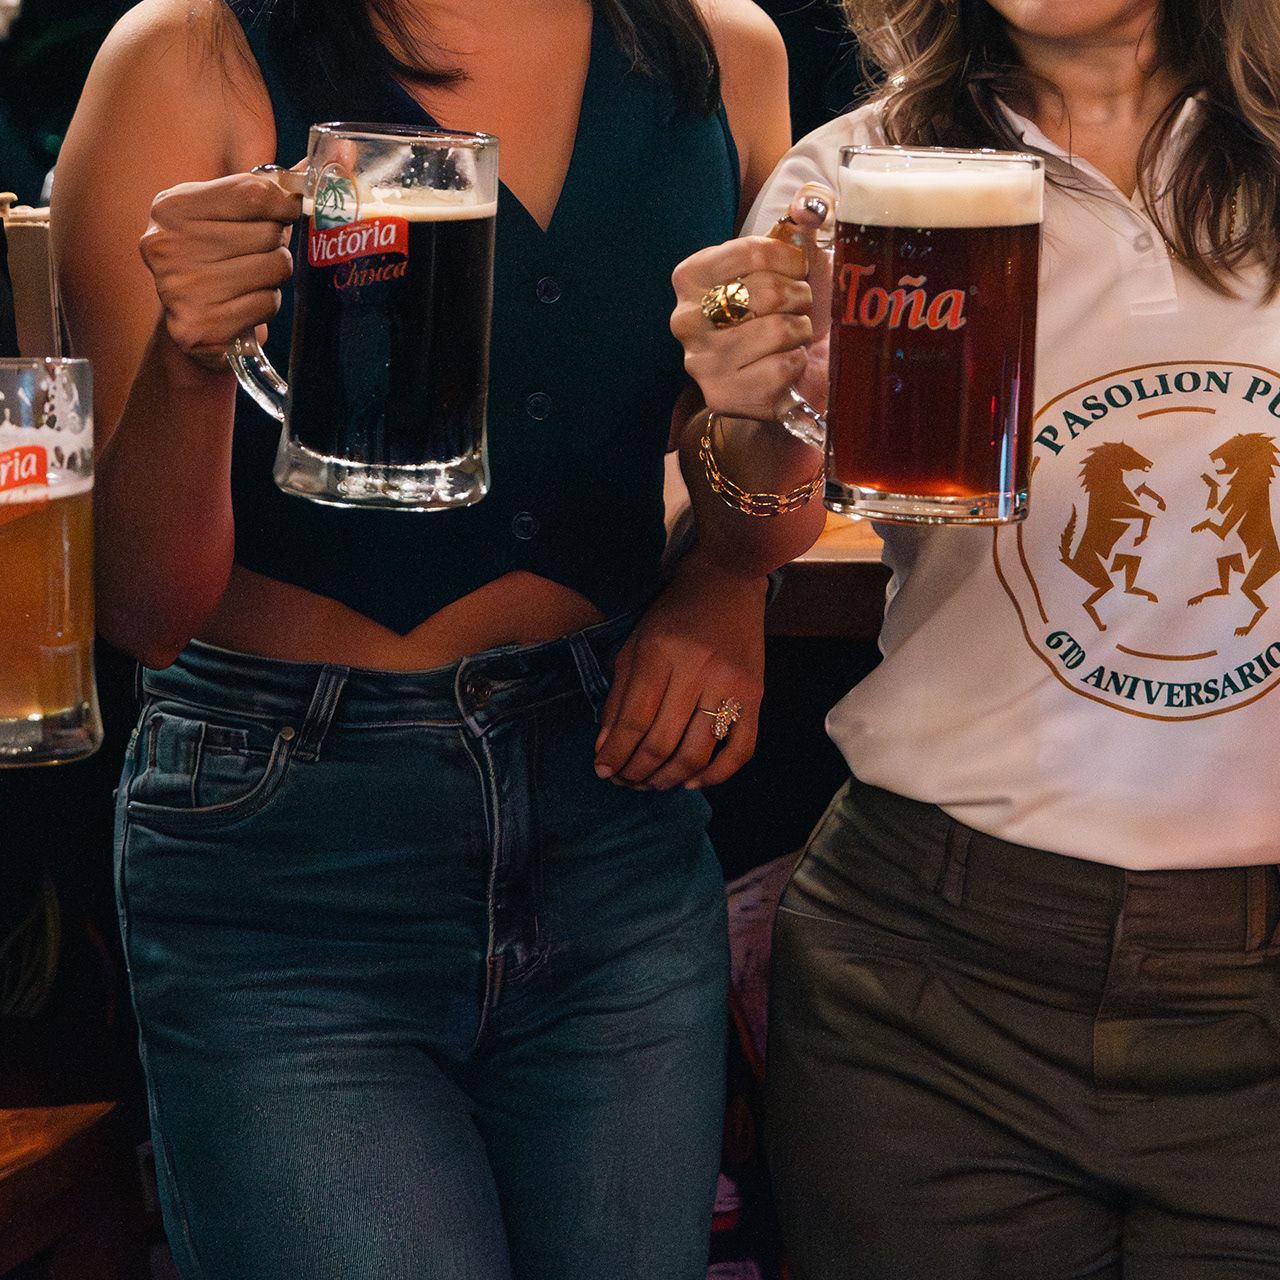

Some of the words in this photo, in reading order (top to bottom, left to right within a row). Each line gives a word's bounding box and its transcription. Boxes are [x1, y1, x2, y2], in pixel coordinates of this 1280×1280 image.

[311, 220, 396, 262] Victoria
[838, 263, 967, 330] Toña
[1034, 371, 1233, 456] PASOLION
